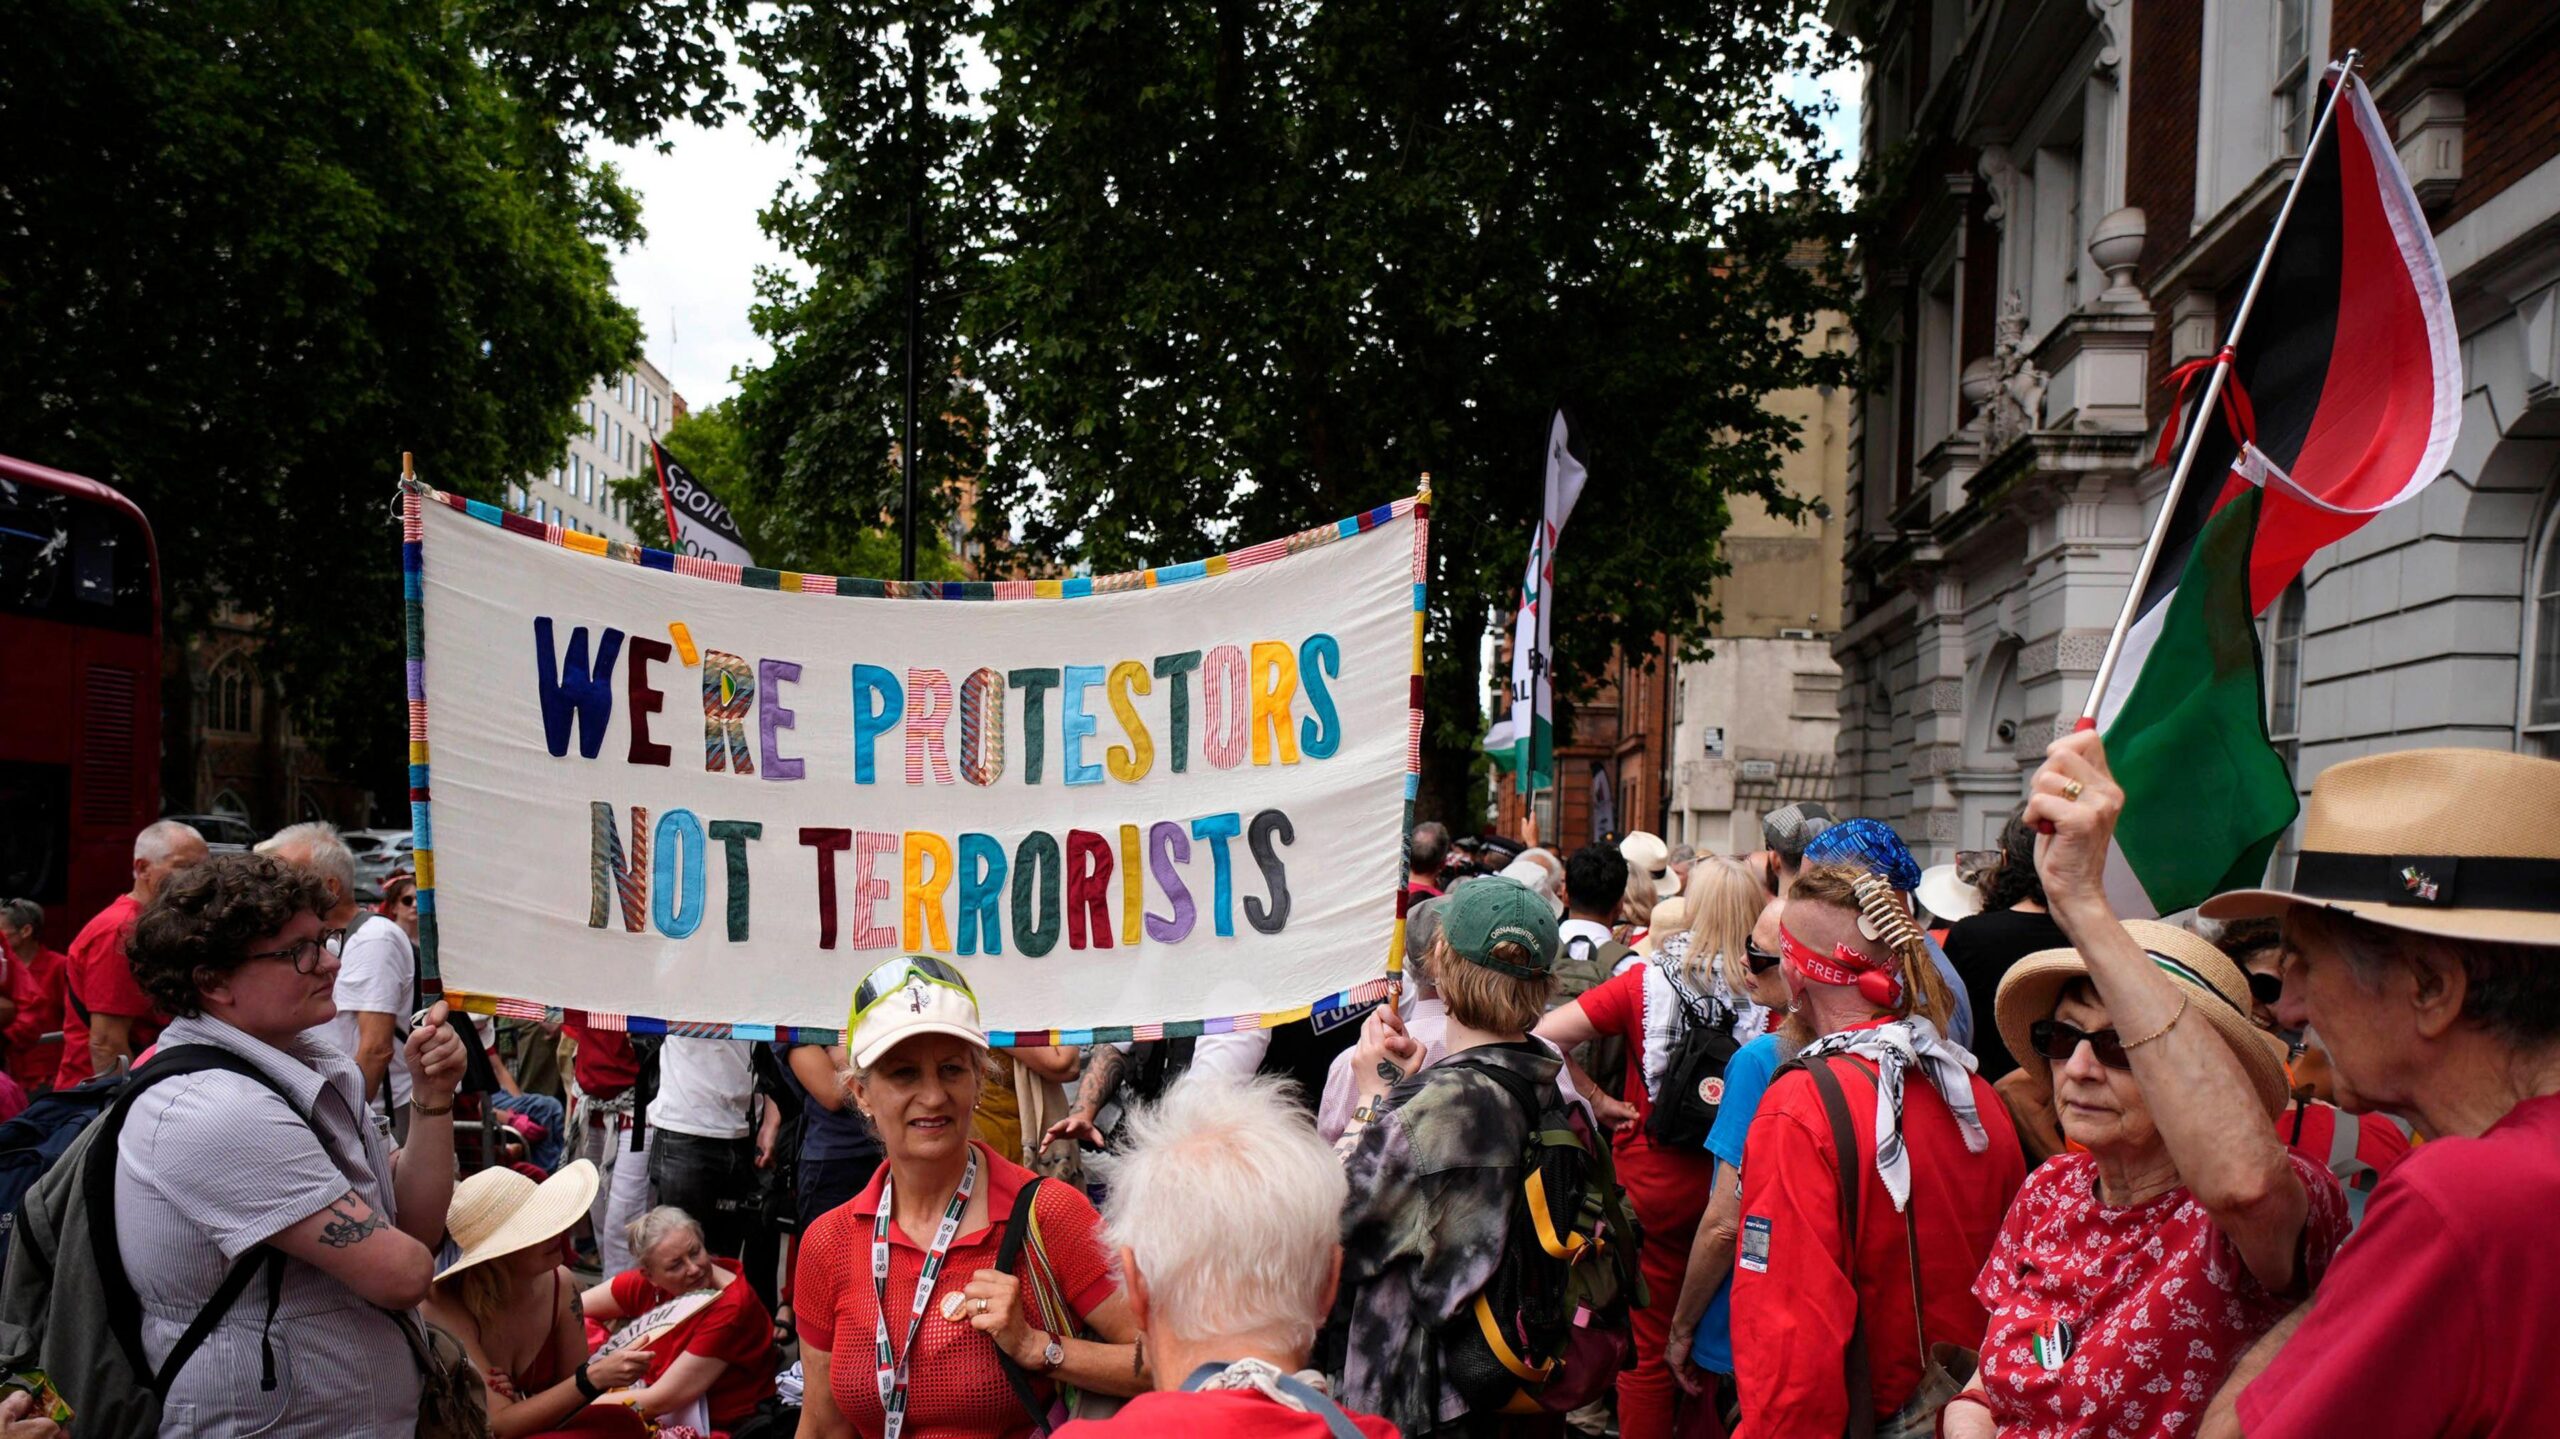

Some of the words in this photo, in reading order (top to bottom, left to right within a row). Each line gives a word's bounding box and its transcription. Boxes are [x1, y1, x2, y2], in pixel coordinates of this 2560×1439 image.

[666, 464, 742, 537] Saoirs
[534, 616, 805, 780] WE'RE
[853, 633, 1339, 786] PROTESTORS
[588, 801, 763, 943] NOT
[799, 808, 1295, 959] TERRORISTS
[1806, 959, 1844, 983] FREE
[1847, 974, 1858, 985] P
